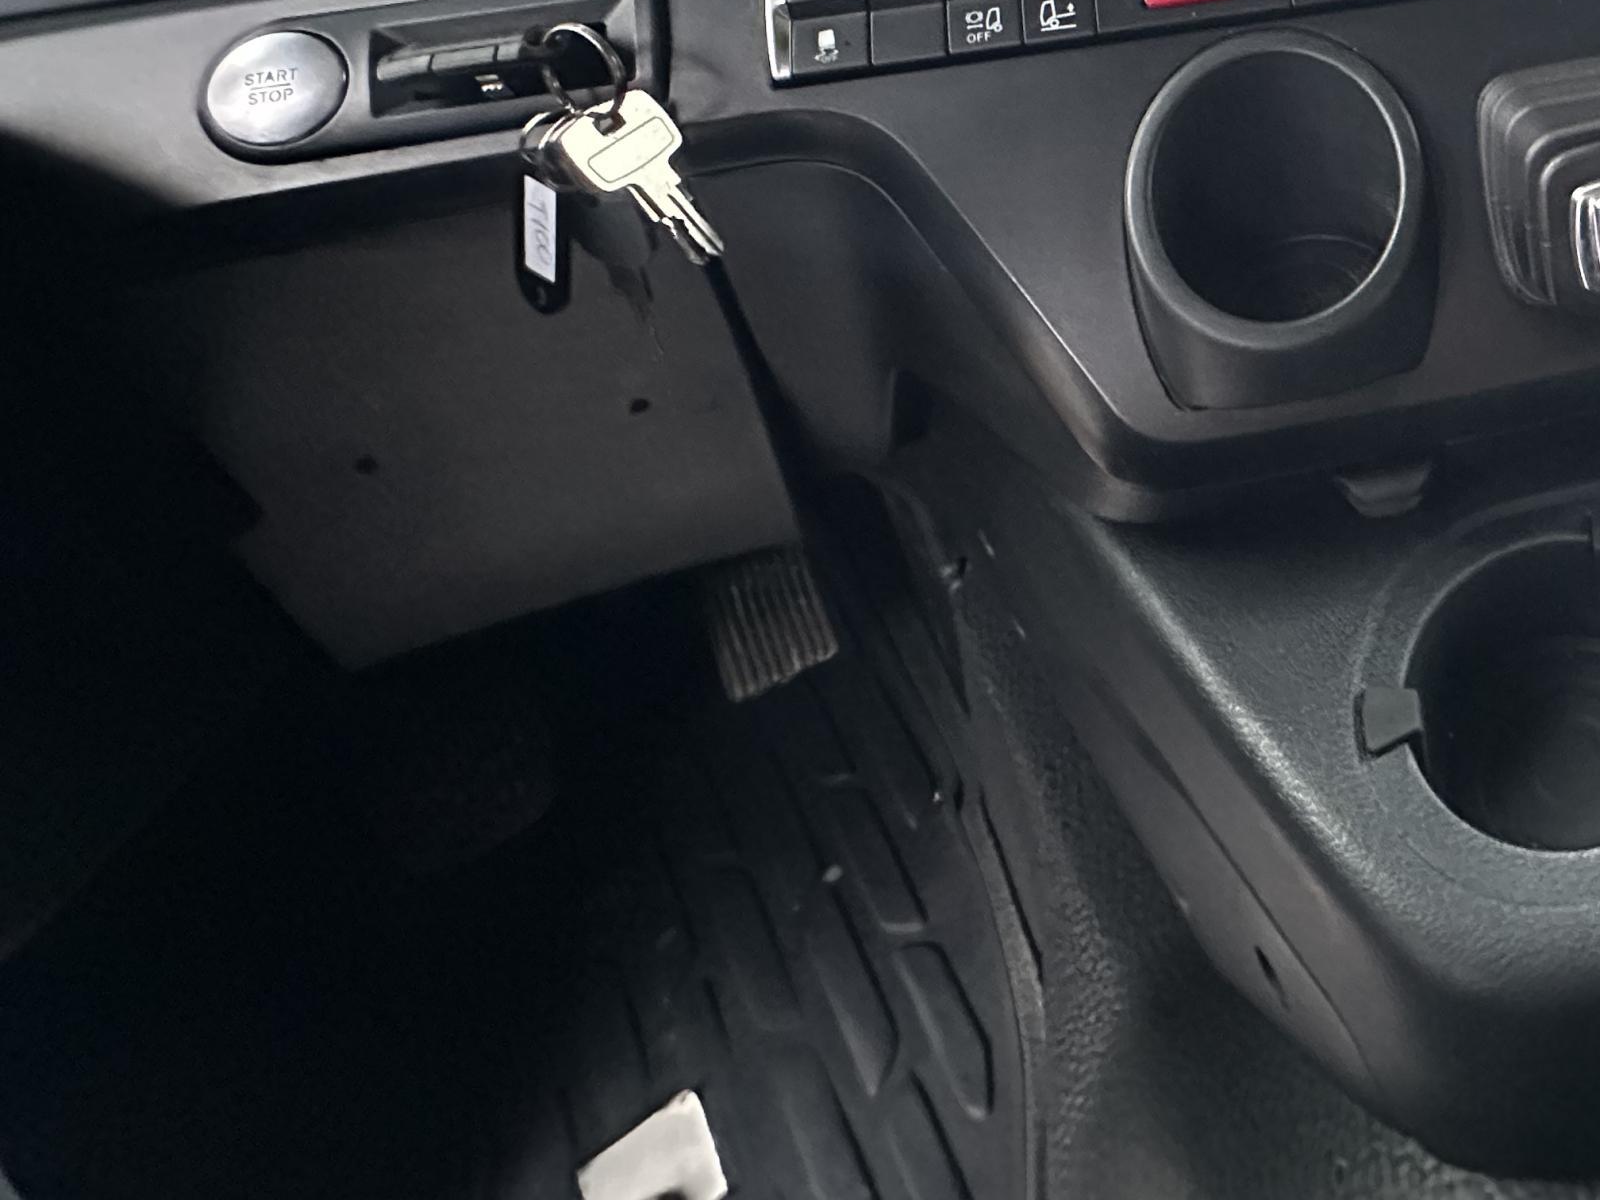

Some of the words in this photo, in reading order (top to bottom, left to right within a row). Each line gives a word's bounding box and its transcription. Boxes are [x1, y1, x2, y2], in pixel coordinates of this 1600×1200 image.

[966, 30, 992, 44] OFF
[244, 67, 299, 86] START
[247, 88, 295, 106] STOP
